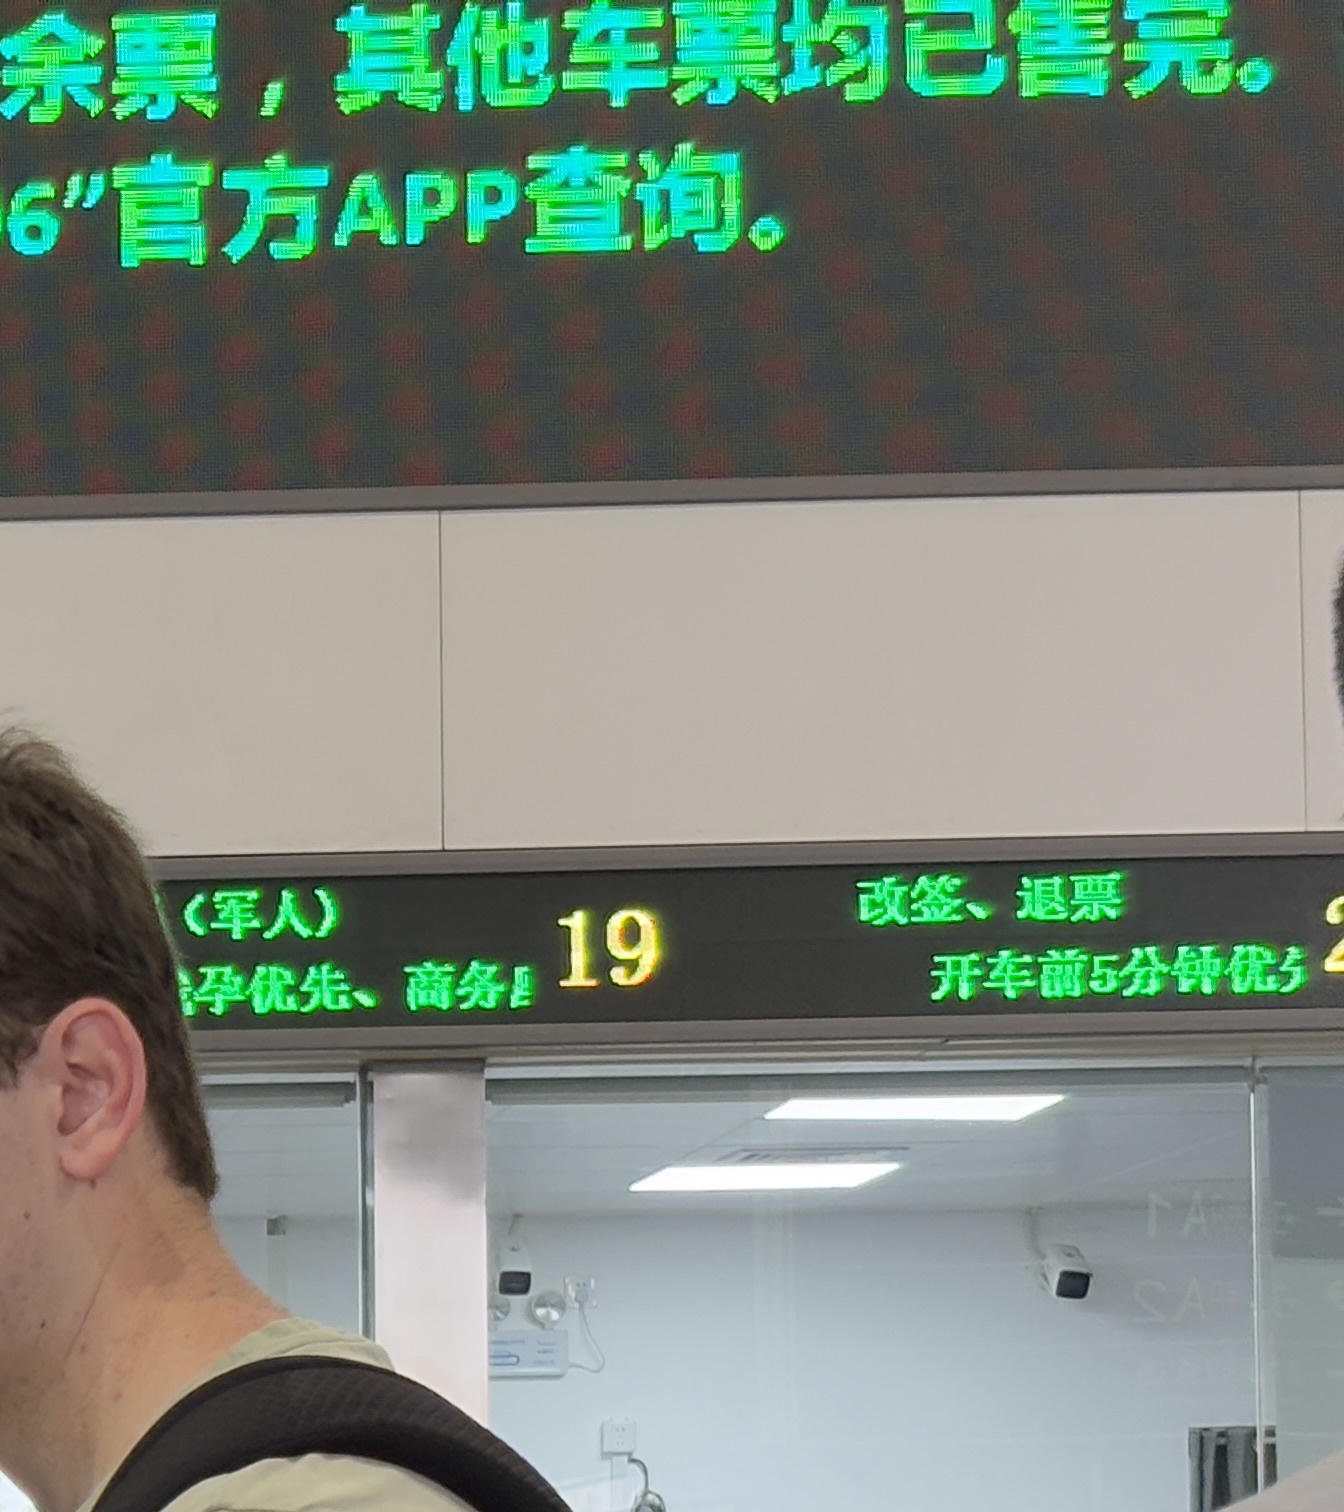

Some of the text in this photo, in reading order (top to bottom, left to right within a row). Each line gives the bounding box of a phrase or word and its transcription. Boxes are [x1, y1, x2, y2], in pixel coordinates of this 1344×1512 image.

[856, 872, 1124, 925] 改签、退票
[559, 910, 660, 986] 19
